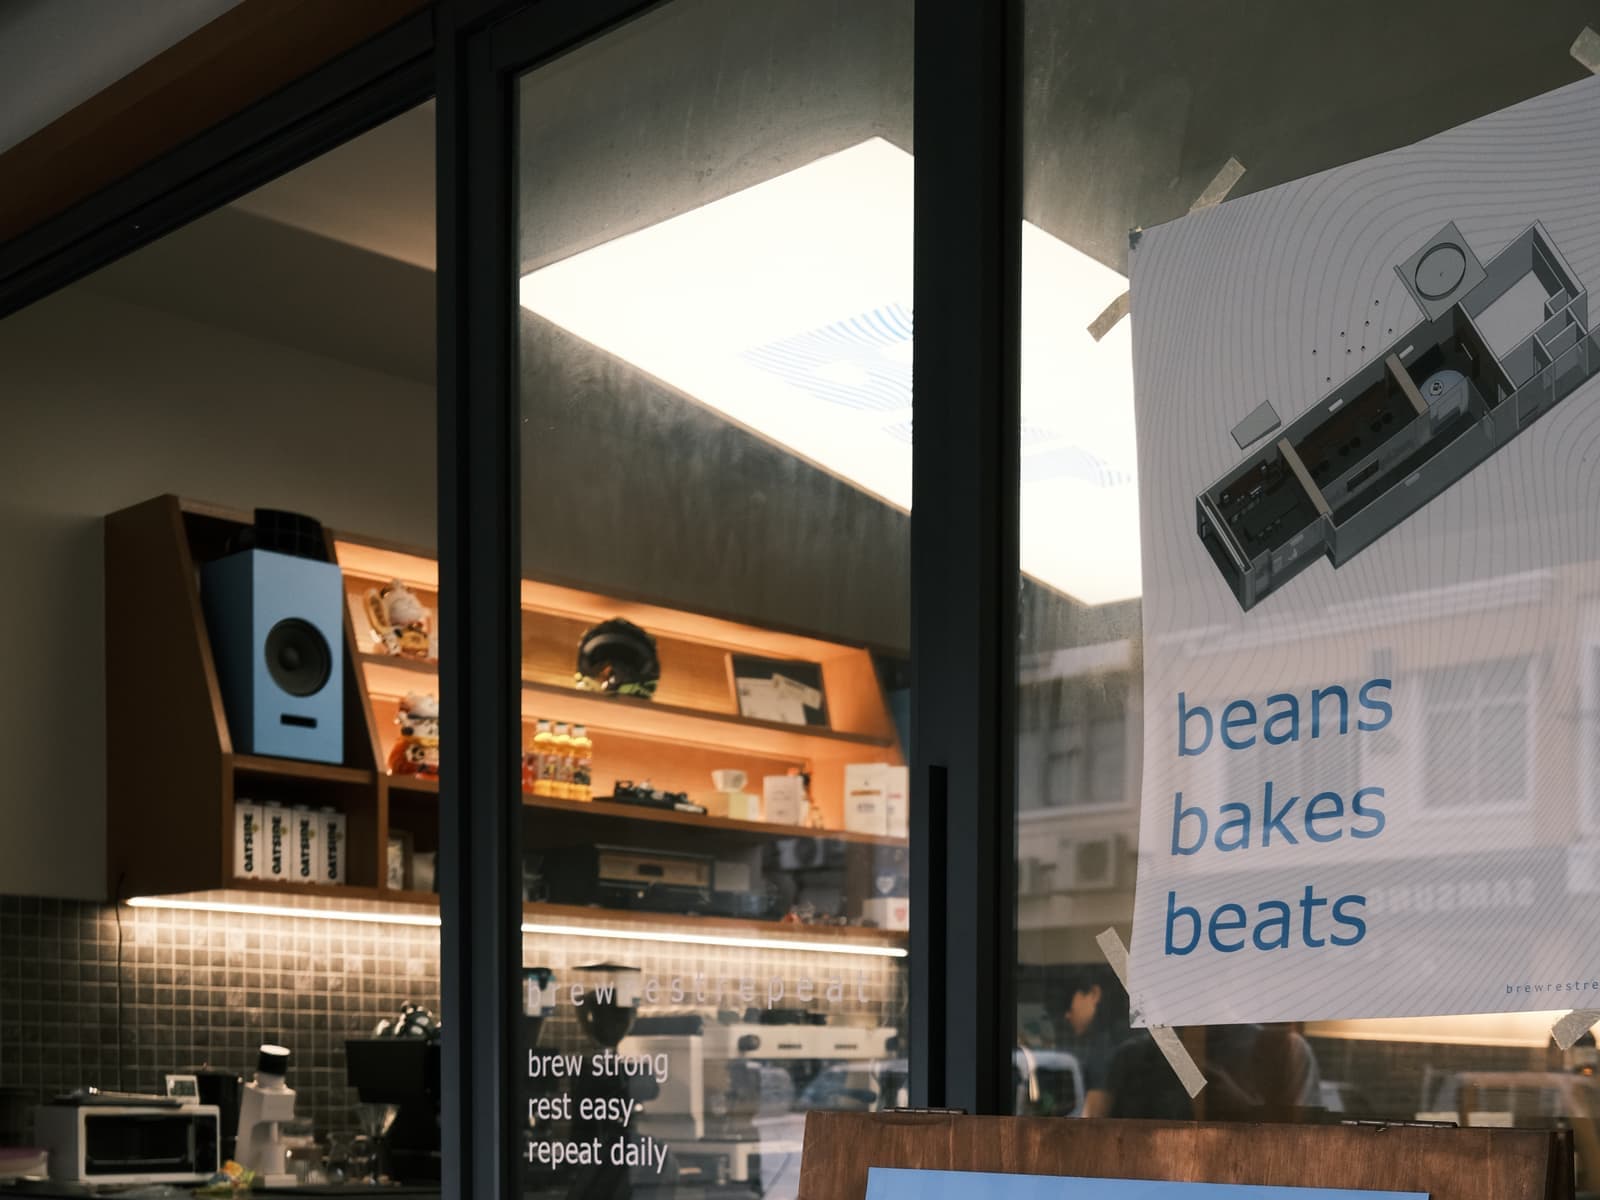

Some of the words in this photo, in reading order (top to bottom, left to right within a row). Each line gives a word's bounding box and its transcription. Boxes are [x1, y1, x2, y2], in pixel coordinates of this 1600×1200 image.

[1178, 678, 1393, 756] beans
[1171, 780, 1386, 855] bakes
[1164, 884, 1367, 956] beats
[527, 967, 871, 1010] brewestrepeat
[1506, 981, 1600, 994] brewrestre
[528, 1049, 583, 1078] brew
[592, 1051, 669, 1083] strong
[528, 1095, 572, 1121] rest
[579, 1098, 635, 1127] easy
[528, 1140, 603, 1170] repeat
[610, 1137, 669, 1174] daily
